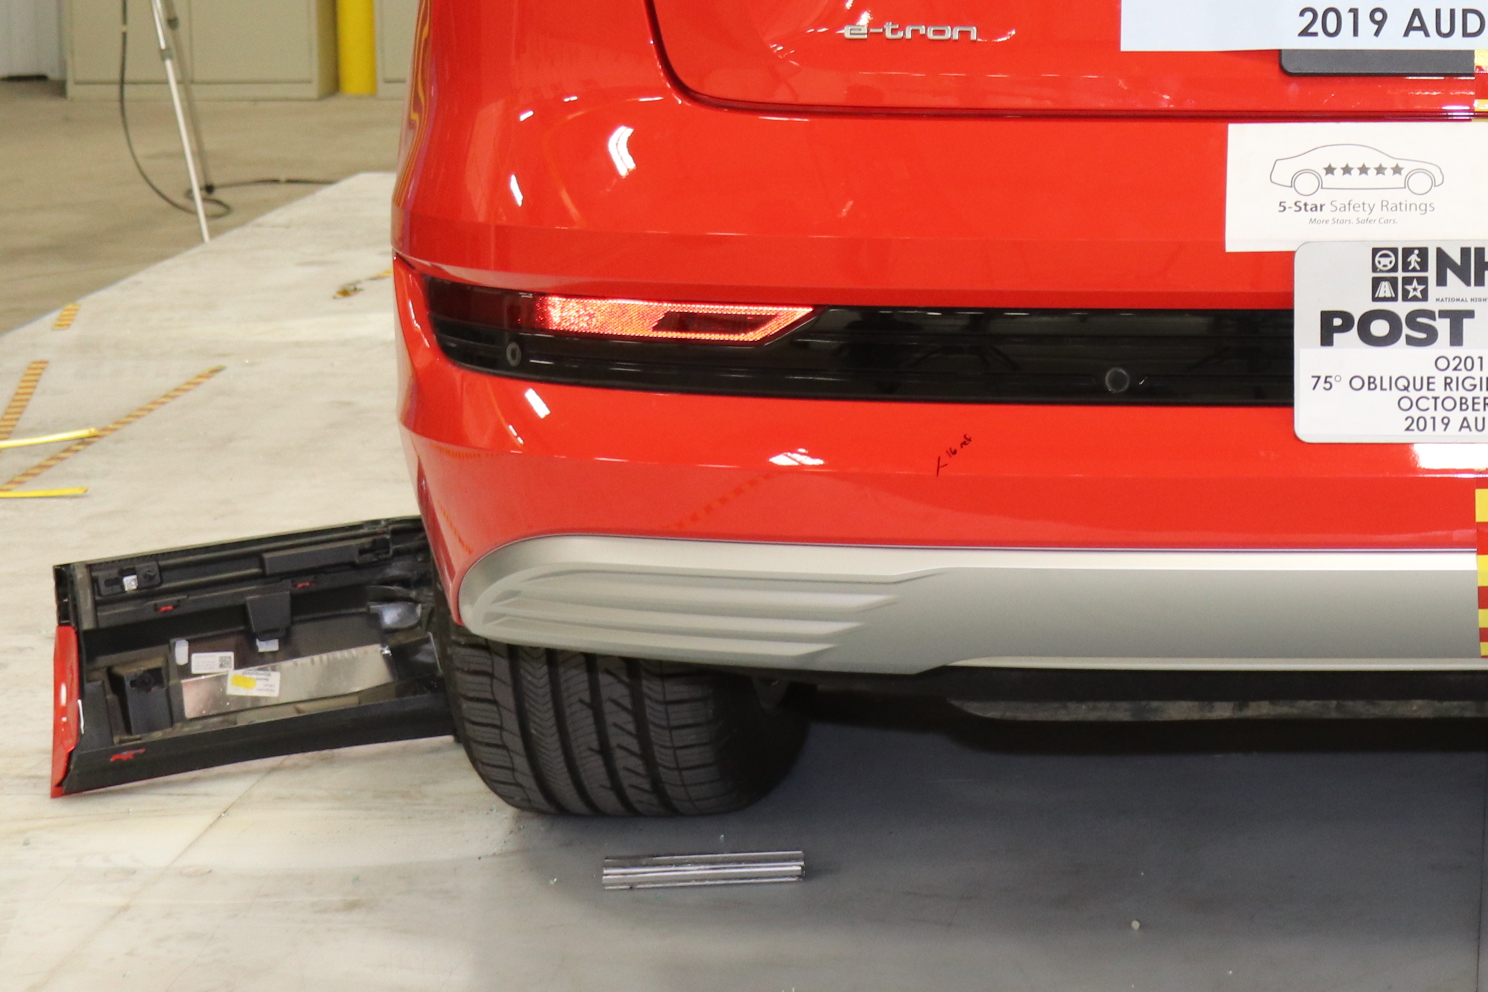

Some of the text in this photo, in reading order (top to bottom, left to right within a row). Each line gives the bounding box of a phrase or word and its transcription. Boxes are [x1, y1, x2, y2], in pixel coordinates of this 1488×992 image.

[843, 21, 978, 41] e-tron
[1297, 6, 1388, 38] 2019
[1278, 199, 1436, 216] 5-Star Safety Ratings
[1308, 216, 1399, 225] More Stars. Safer Cars.
[1319, 308, 1475, 347] POST
[1349, 374, 1436, 393] OBLIQUE
[1404, 416, 1451, 432] 2019
